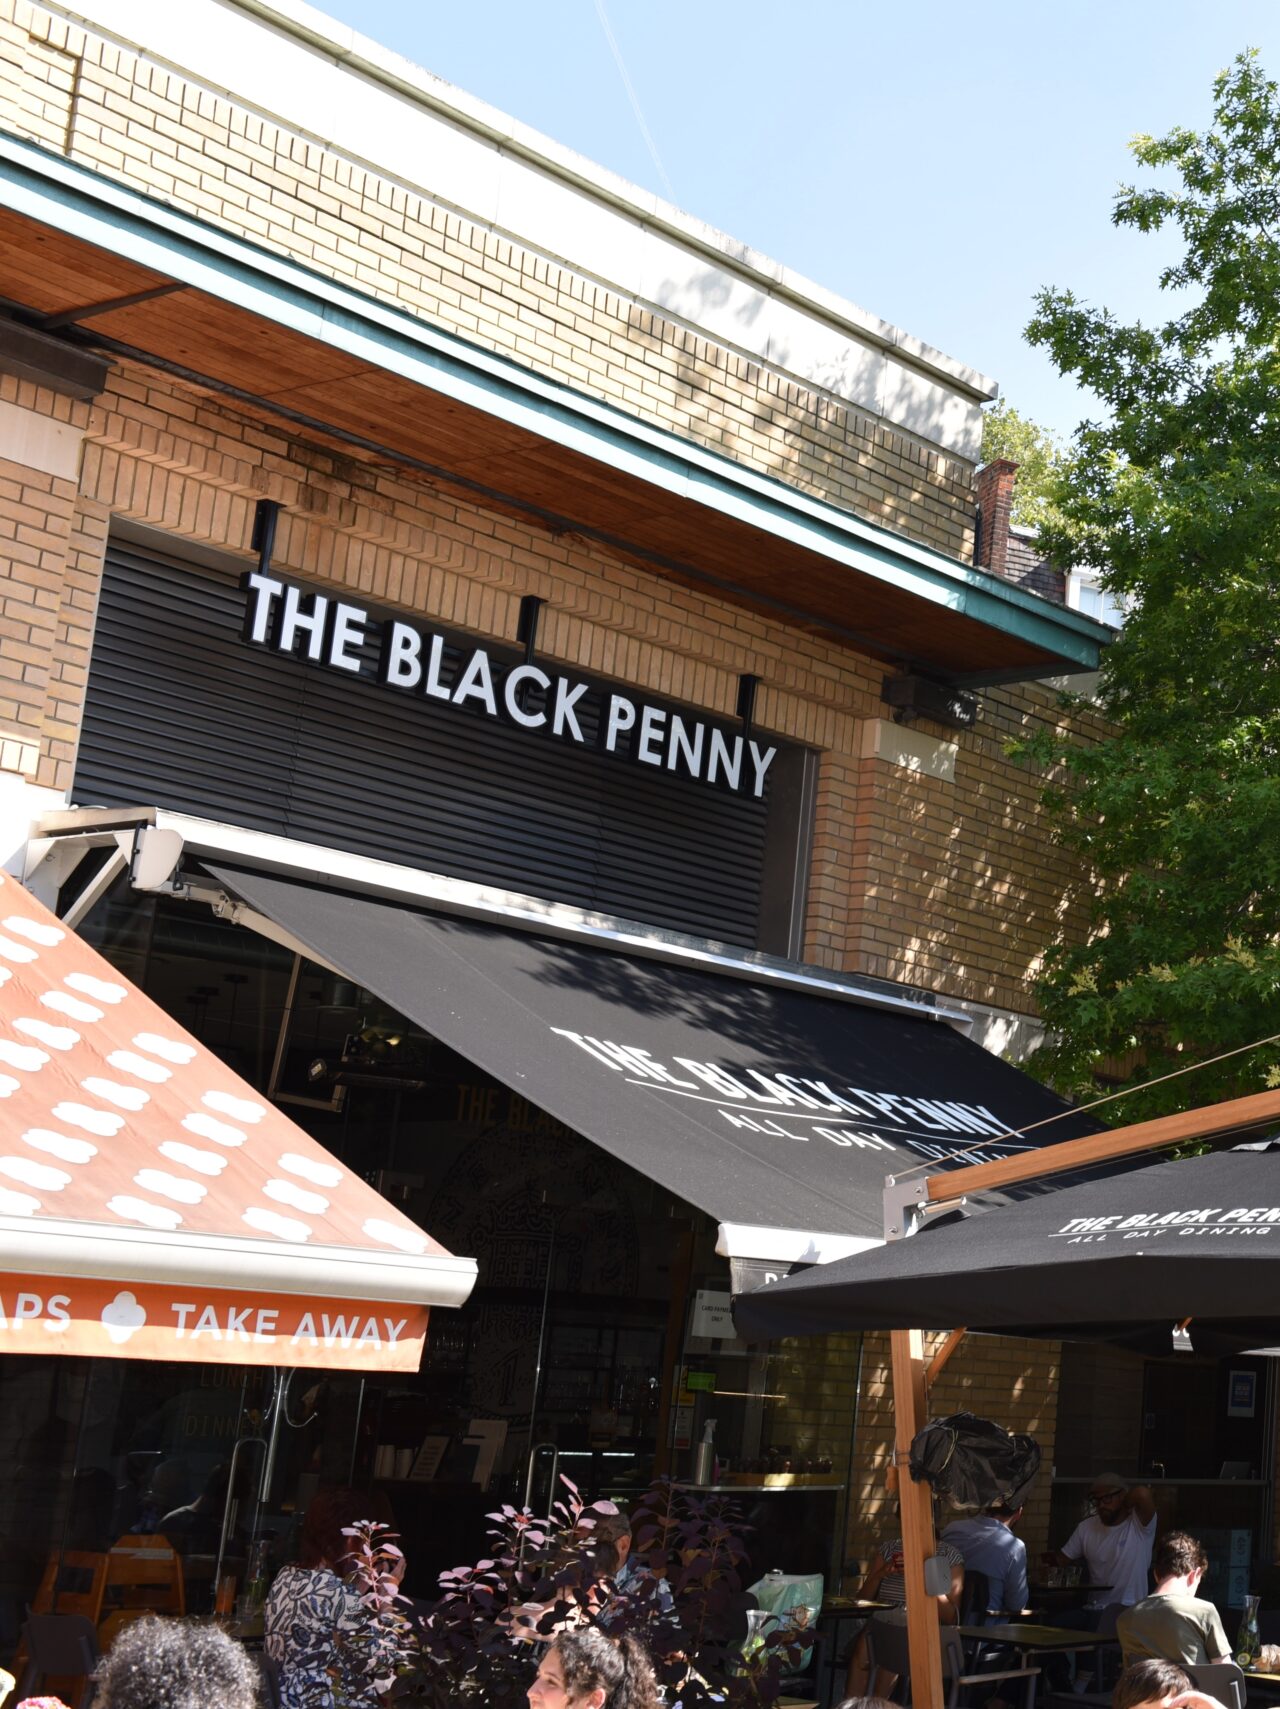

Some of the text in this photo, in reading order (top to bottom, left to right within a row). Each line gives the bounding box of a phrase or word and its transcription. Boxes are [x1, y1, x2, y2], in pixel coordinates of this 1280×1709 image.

[247, 572, 777, 798] THE BLACK PENNY
[550, 1026, 1025, 1138] THE BLACK PENNY
[718, 1109, 809, 1141] ALL
[812, 1126, 897, 1151] DAY
[1058, 1215, 1122, 1233] THE
[1115, 1208, 1222, 1229] BLACK
[1067, 1226, 1272, 1244] ALL DAY DINING
[171, 1302, 408, 1352] TAKE AWAY
